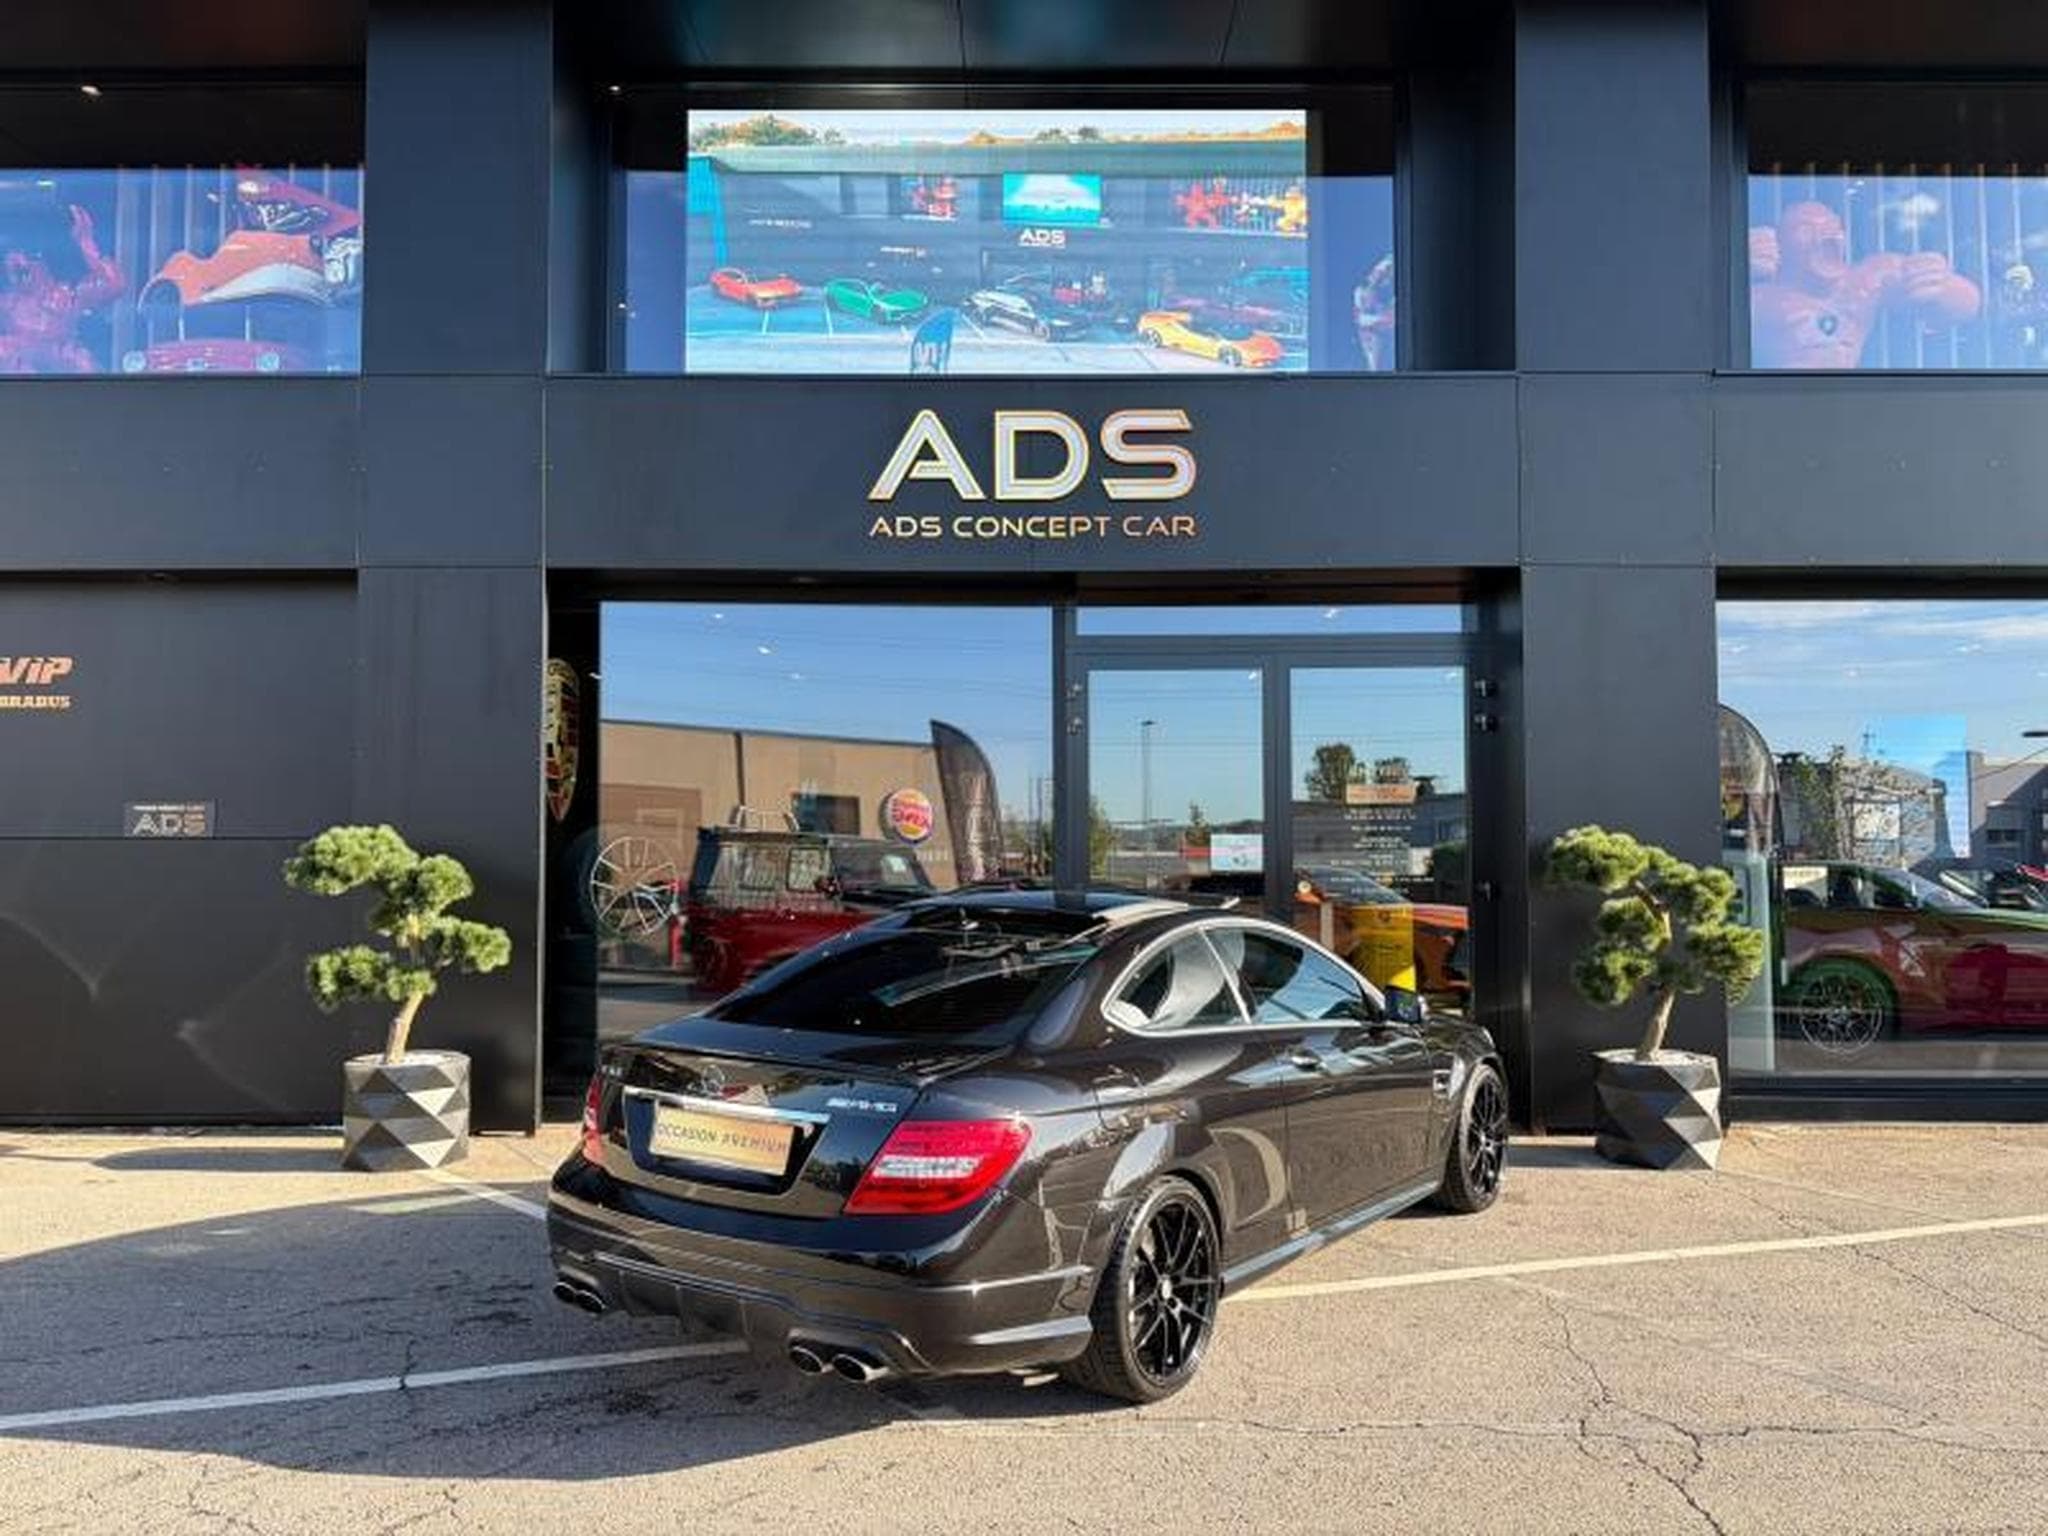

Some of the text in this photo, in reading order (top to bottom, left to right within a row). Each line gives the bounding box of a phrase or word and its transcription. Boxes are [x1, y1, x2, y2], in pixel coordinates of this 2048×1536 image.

[1020, 228, 1065, 243] ADS
[868, 409, 1197, 500] ADS
[869, 516, 1197, 538] ADS CONCEPT CAR
[133, 813, 206, 836] ADS
[657, 1122, 717, 1144] OCCASION
